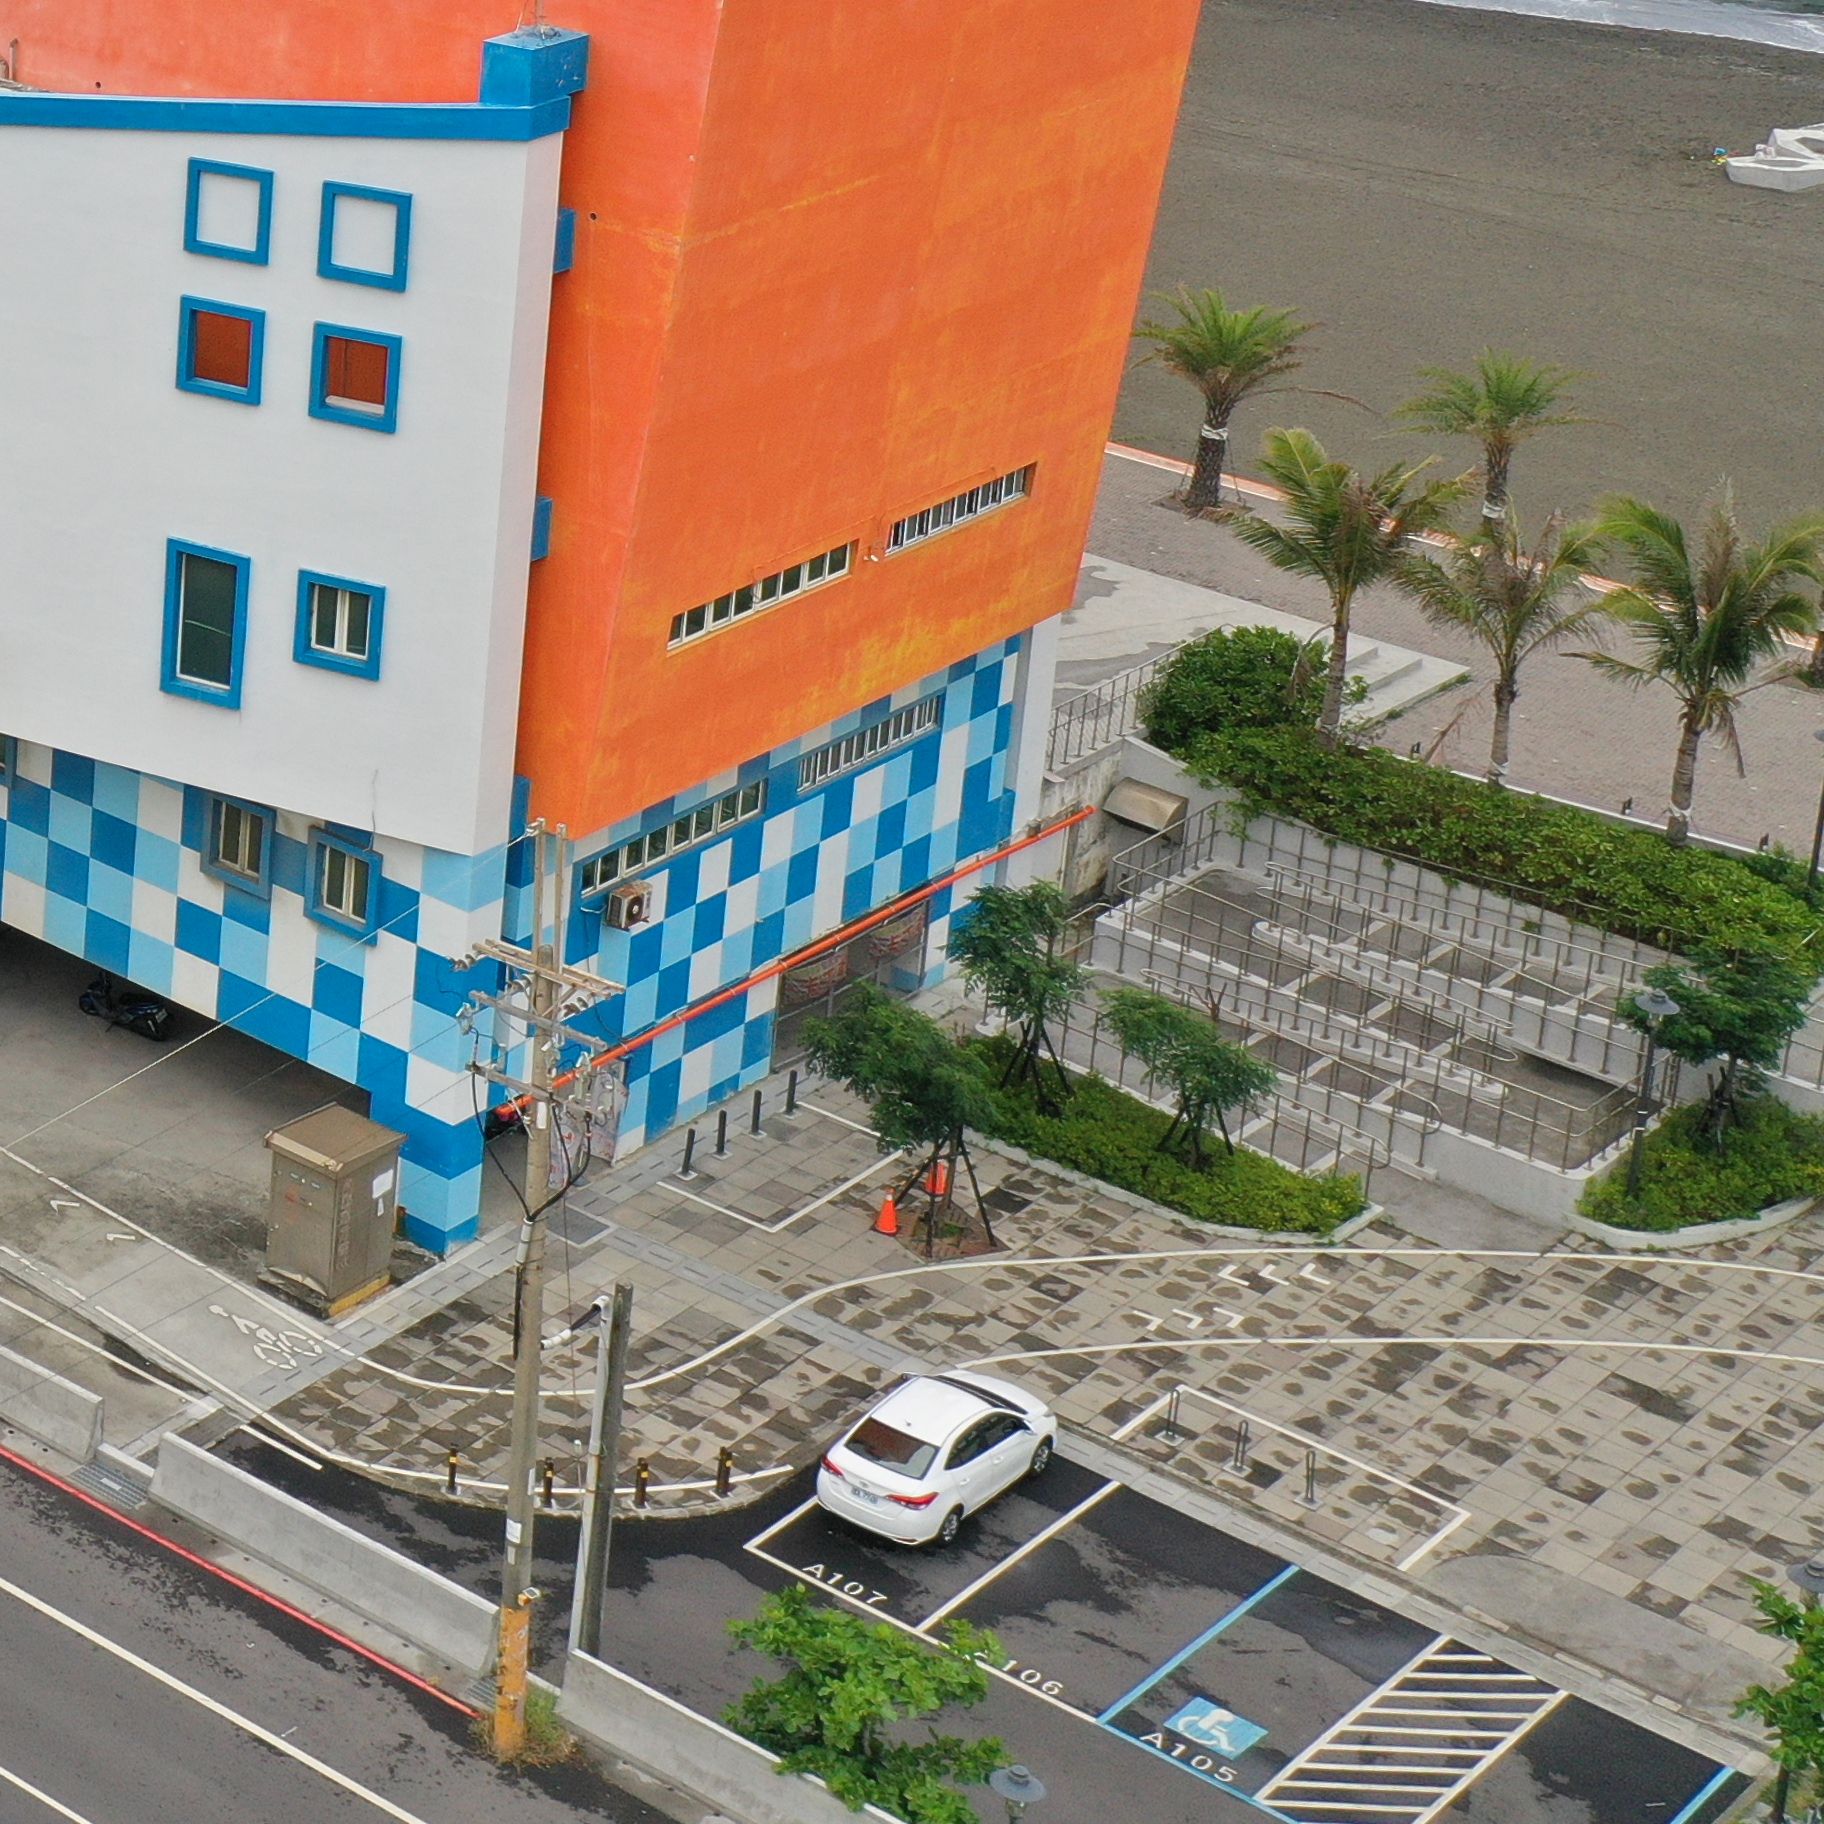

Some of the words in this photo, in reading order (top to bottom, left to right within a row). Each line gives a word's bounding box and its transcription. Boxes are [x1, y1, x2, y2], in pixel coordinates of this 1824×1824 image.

[802, 1563, 888, 1605] A107
[965, 1650, 1065, 1697] 106
[1139, 1731, 1239, 1783] A105
